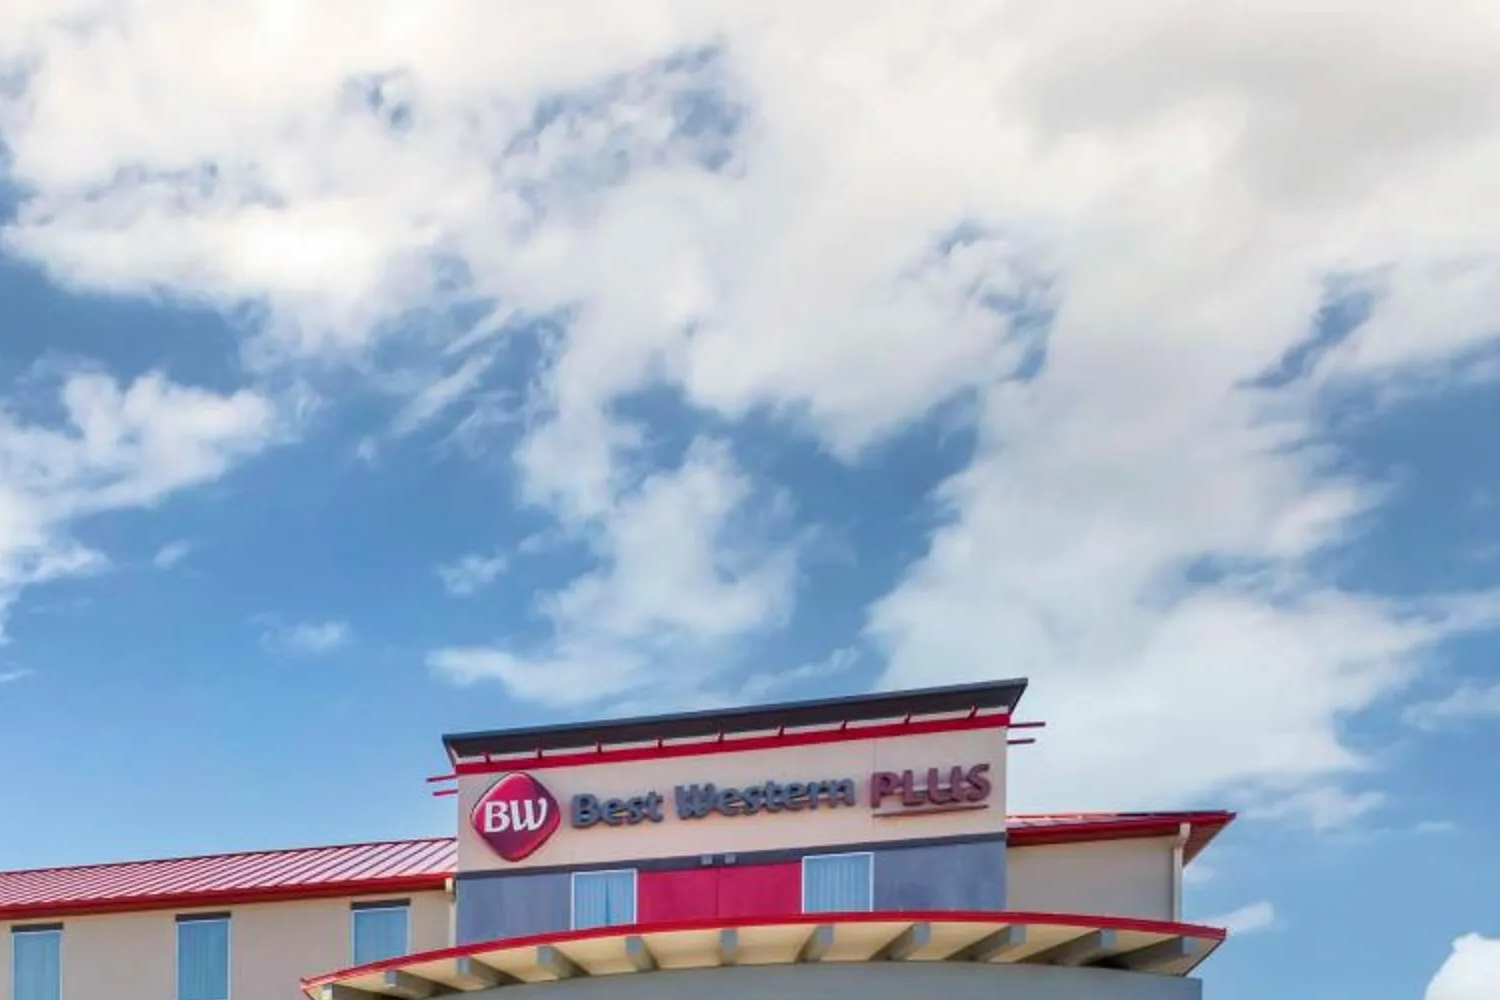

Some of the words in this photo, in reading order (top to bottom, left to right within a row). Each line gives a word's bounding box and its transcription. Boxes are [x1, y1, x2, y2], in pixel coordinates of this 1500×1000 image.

[483, 797, 548, 833] BW
[571, 791, 664, 829] Best
[674, 777, 856, 821] Western
[869, 763, 991, 809] PLUS
